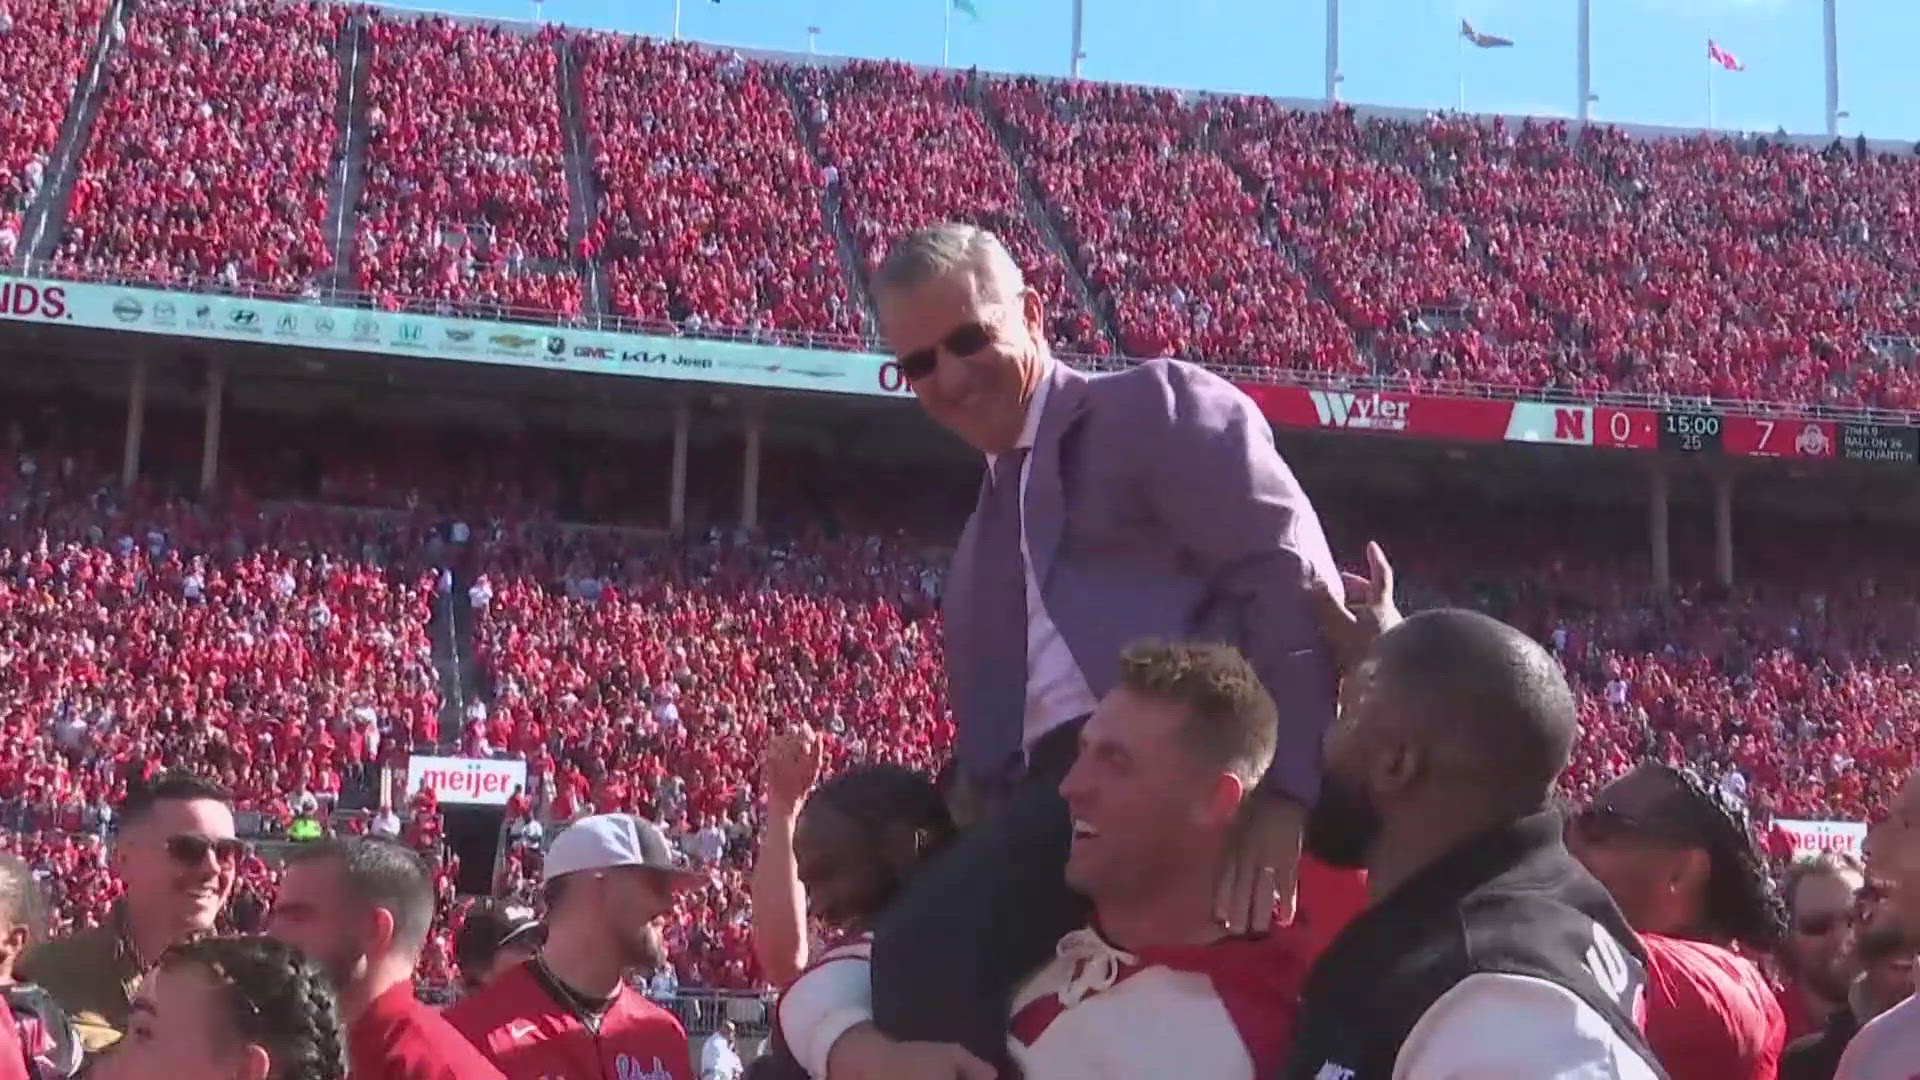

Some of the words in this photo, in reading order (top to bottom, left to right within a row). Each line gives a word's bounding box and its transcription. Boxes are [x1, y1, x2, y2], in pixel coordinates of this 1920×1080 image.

[672, 355, 713, 369] Jeep
[1309, 390, 1410, 426] Wyler
[1555, 409, 1584, 439] N
[1611, 412, 1630, 441] 0
[1666, 415, 1719, 435] 15:00
[1756, 421, 1774, 450] 7
[423, 764, 511, 798] meijer
